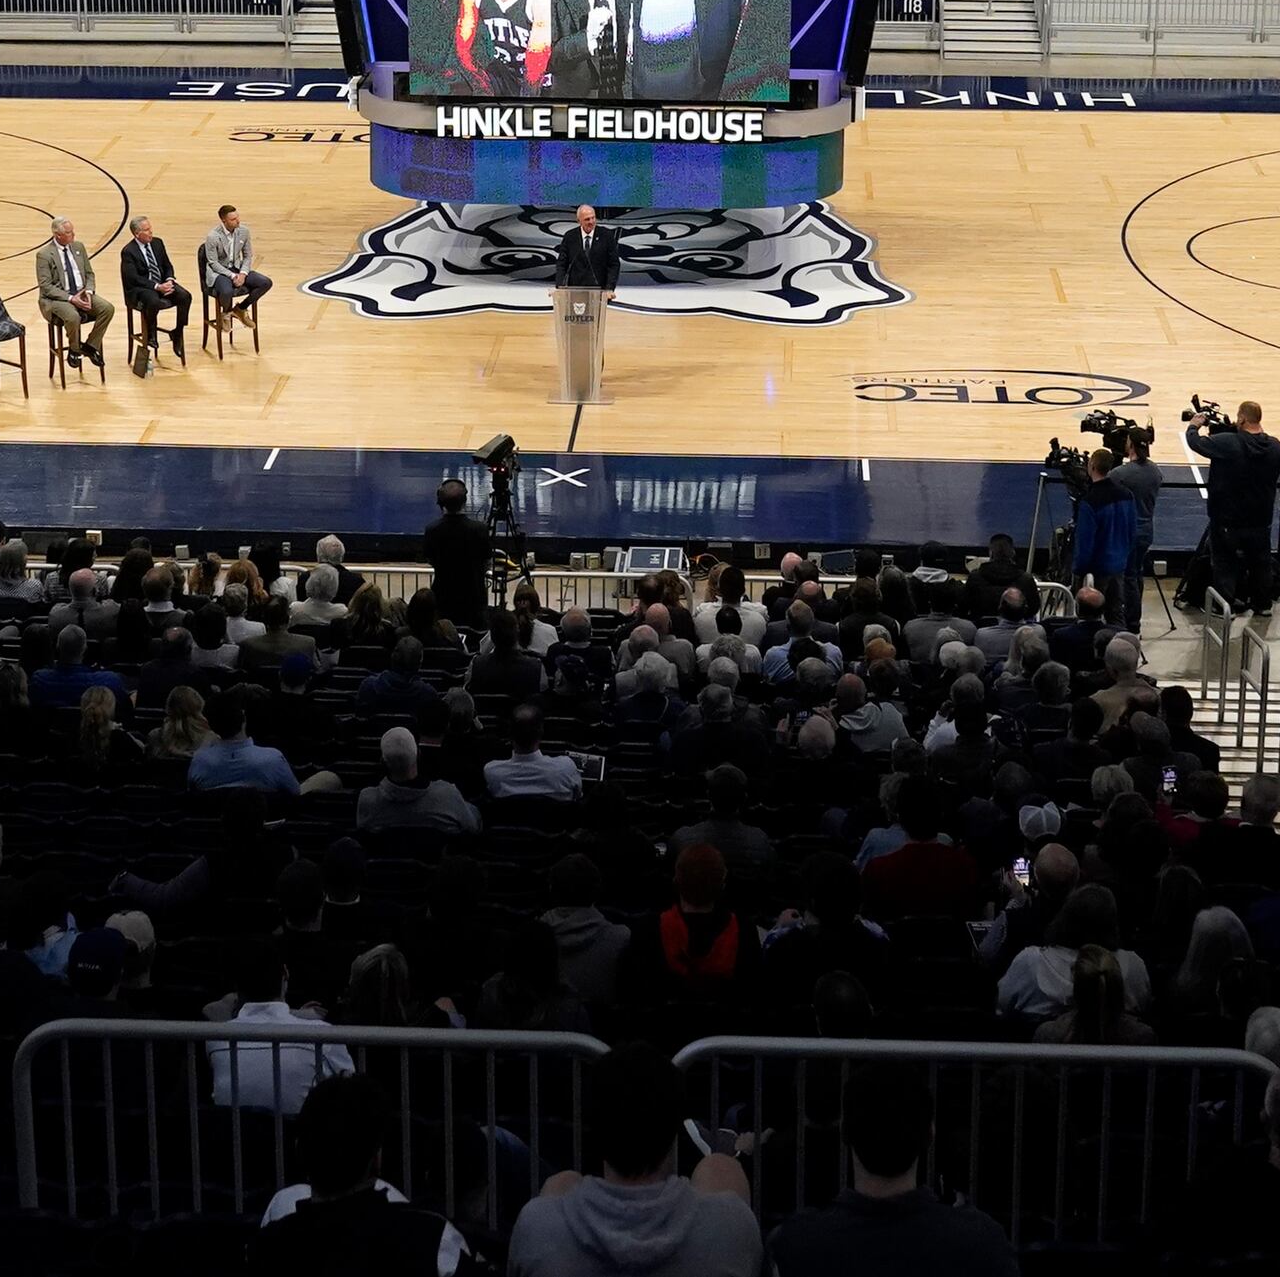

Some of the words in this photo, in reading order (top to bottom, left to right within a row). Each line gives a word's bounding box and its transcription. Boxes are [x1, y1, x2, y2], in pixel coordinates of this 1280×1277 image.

[435, 104, 552, 138] HINKLE
[567, 107, 763, 143] FIELDHOUSE
[565, 314, 595, 323] BUTLER
[851, 375, 1005, 385] PARTNERS
